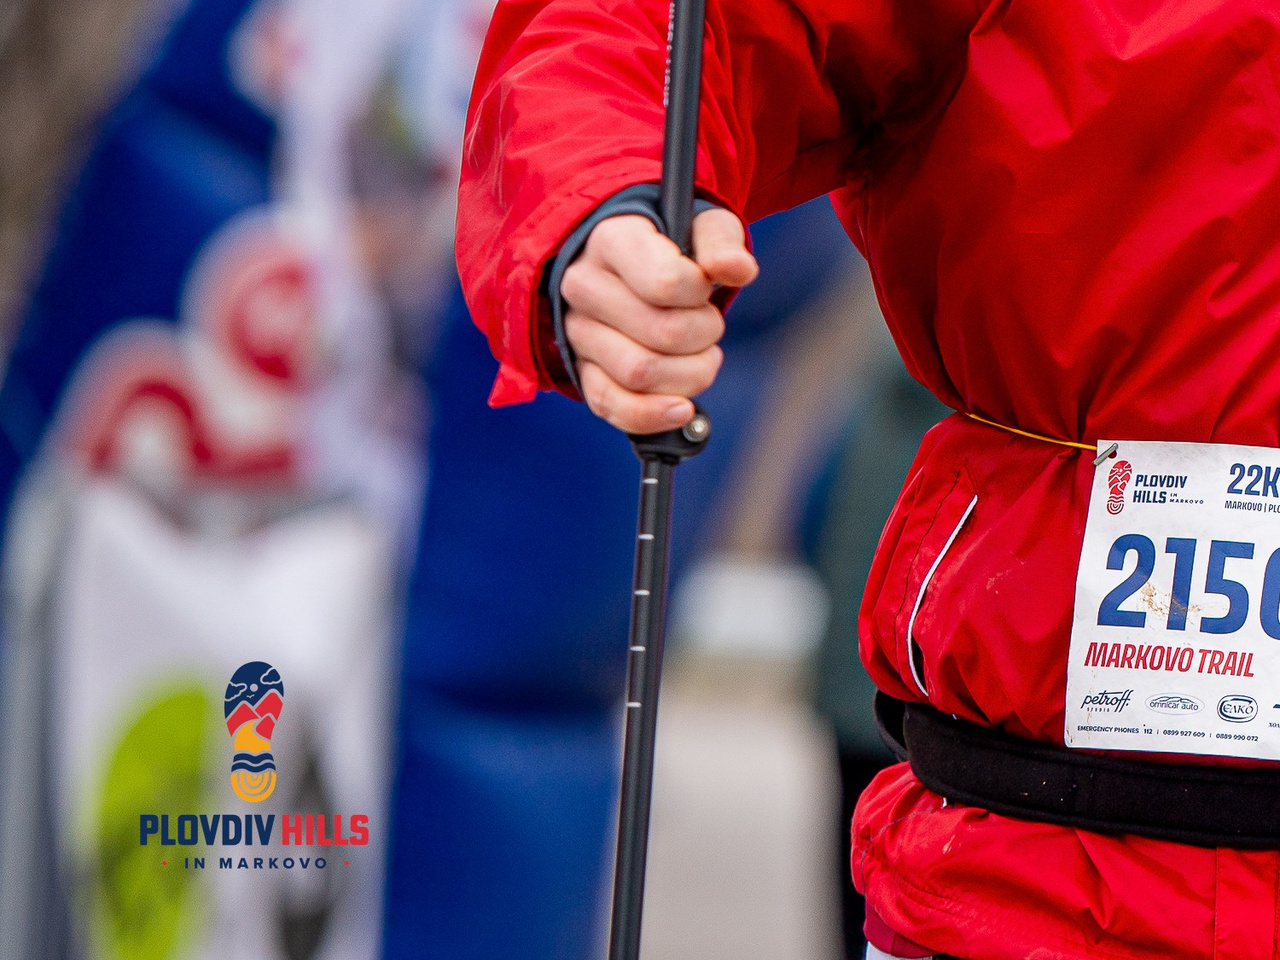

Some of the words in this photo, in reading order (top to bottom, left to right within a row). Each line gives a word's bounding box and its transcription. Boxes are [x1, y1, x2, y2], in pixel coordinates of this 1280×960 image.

[1135, 474, 1188, 488] PLOVDIV
[1132, 490, 1168, 503] HILLS
[1224, 500, 1263, 513] MARKOVO
[1084, 642, 1194, 673] MARKOVO
[1198, 649, 1256, 678] TRAIL
[1149, 700, 1180, 709] omnicar
[1181, 701, 1199, 711] auto
[1077, 725, 1113, 733] EMERGENCY
